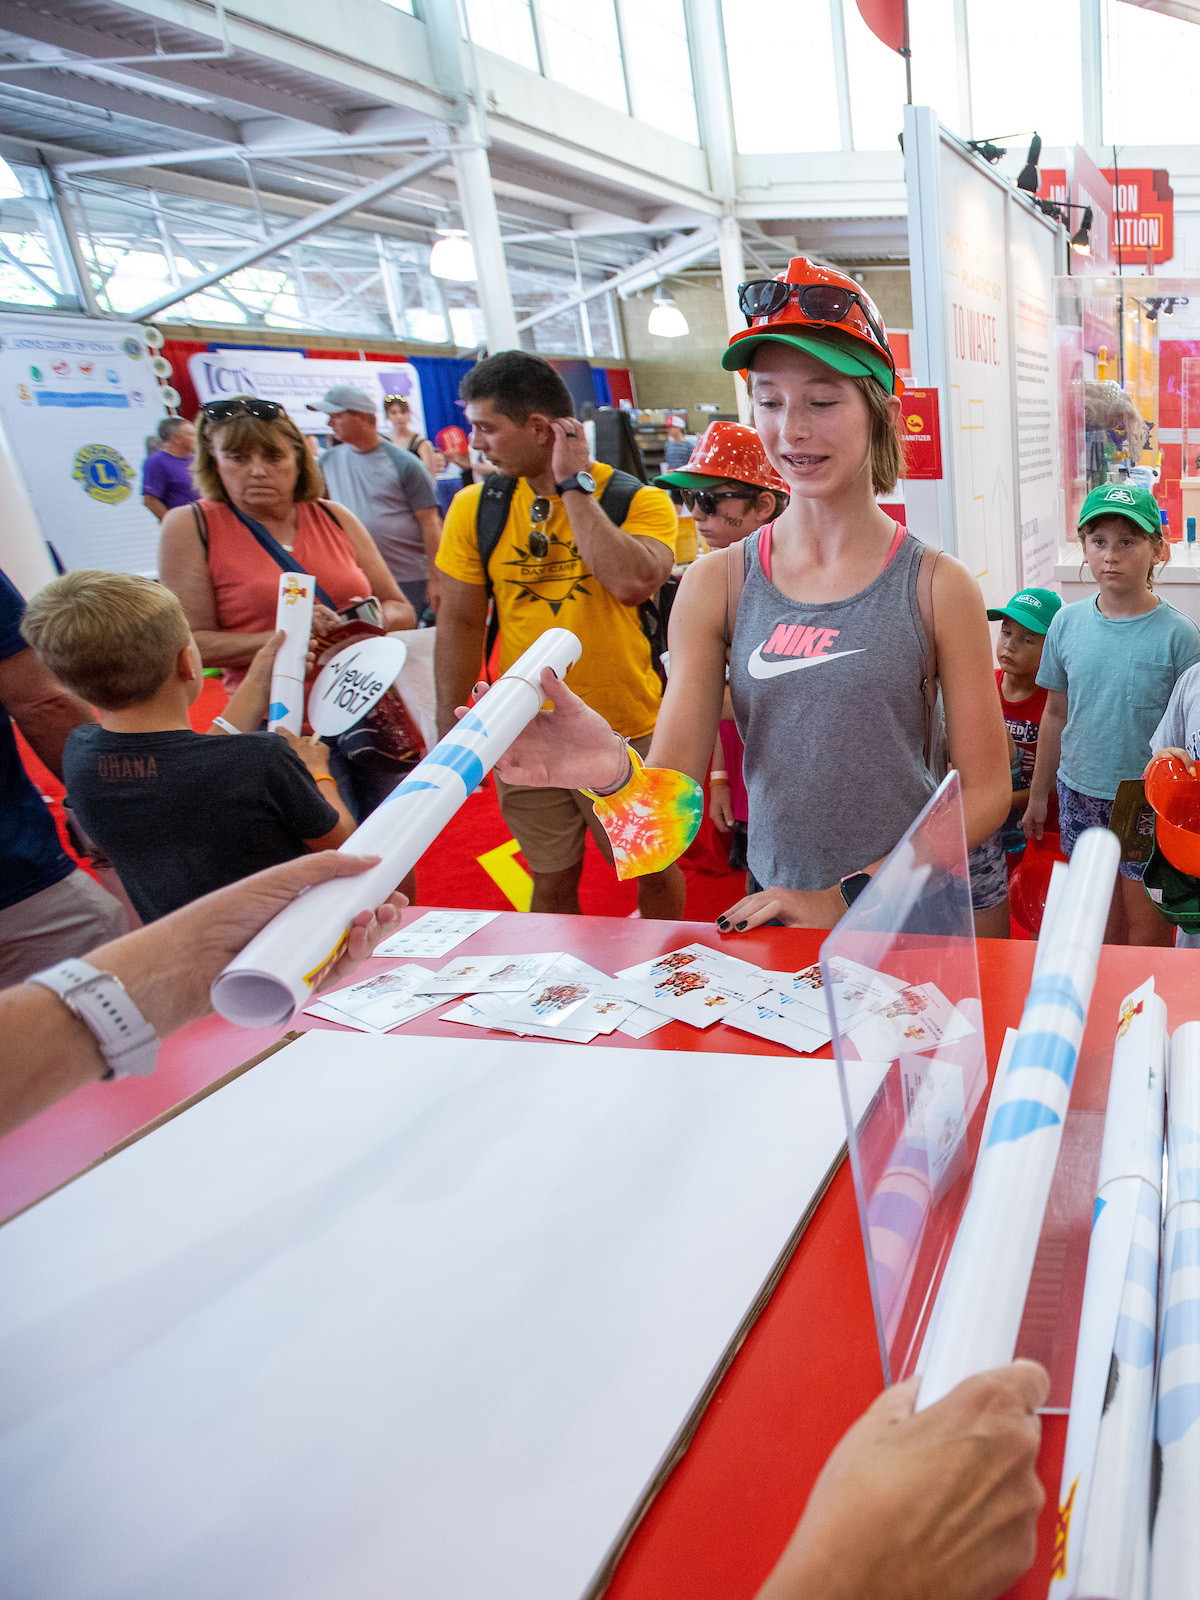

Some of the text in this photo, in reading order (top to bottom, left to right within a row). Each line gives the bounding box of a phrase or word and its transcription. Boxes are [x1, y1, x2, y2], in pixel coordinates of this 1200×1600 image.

[1112, 219, 1159, 246] UTION
[961, 269, 990, 297] PLASTIC
[952, 303, 966, 360] TO
[966, 308, 1001, 367] WASTE.
[548, 562, 578, 573] CAMP
[763, 623, 840, 658] NIKE
